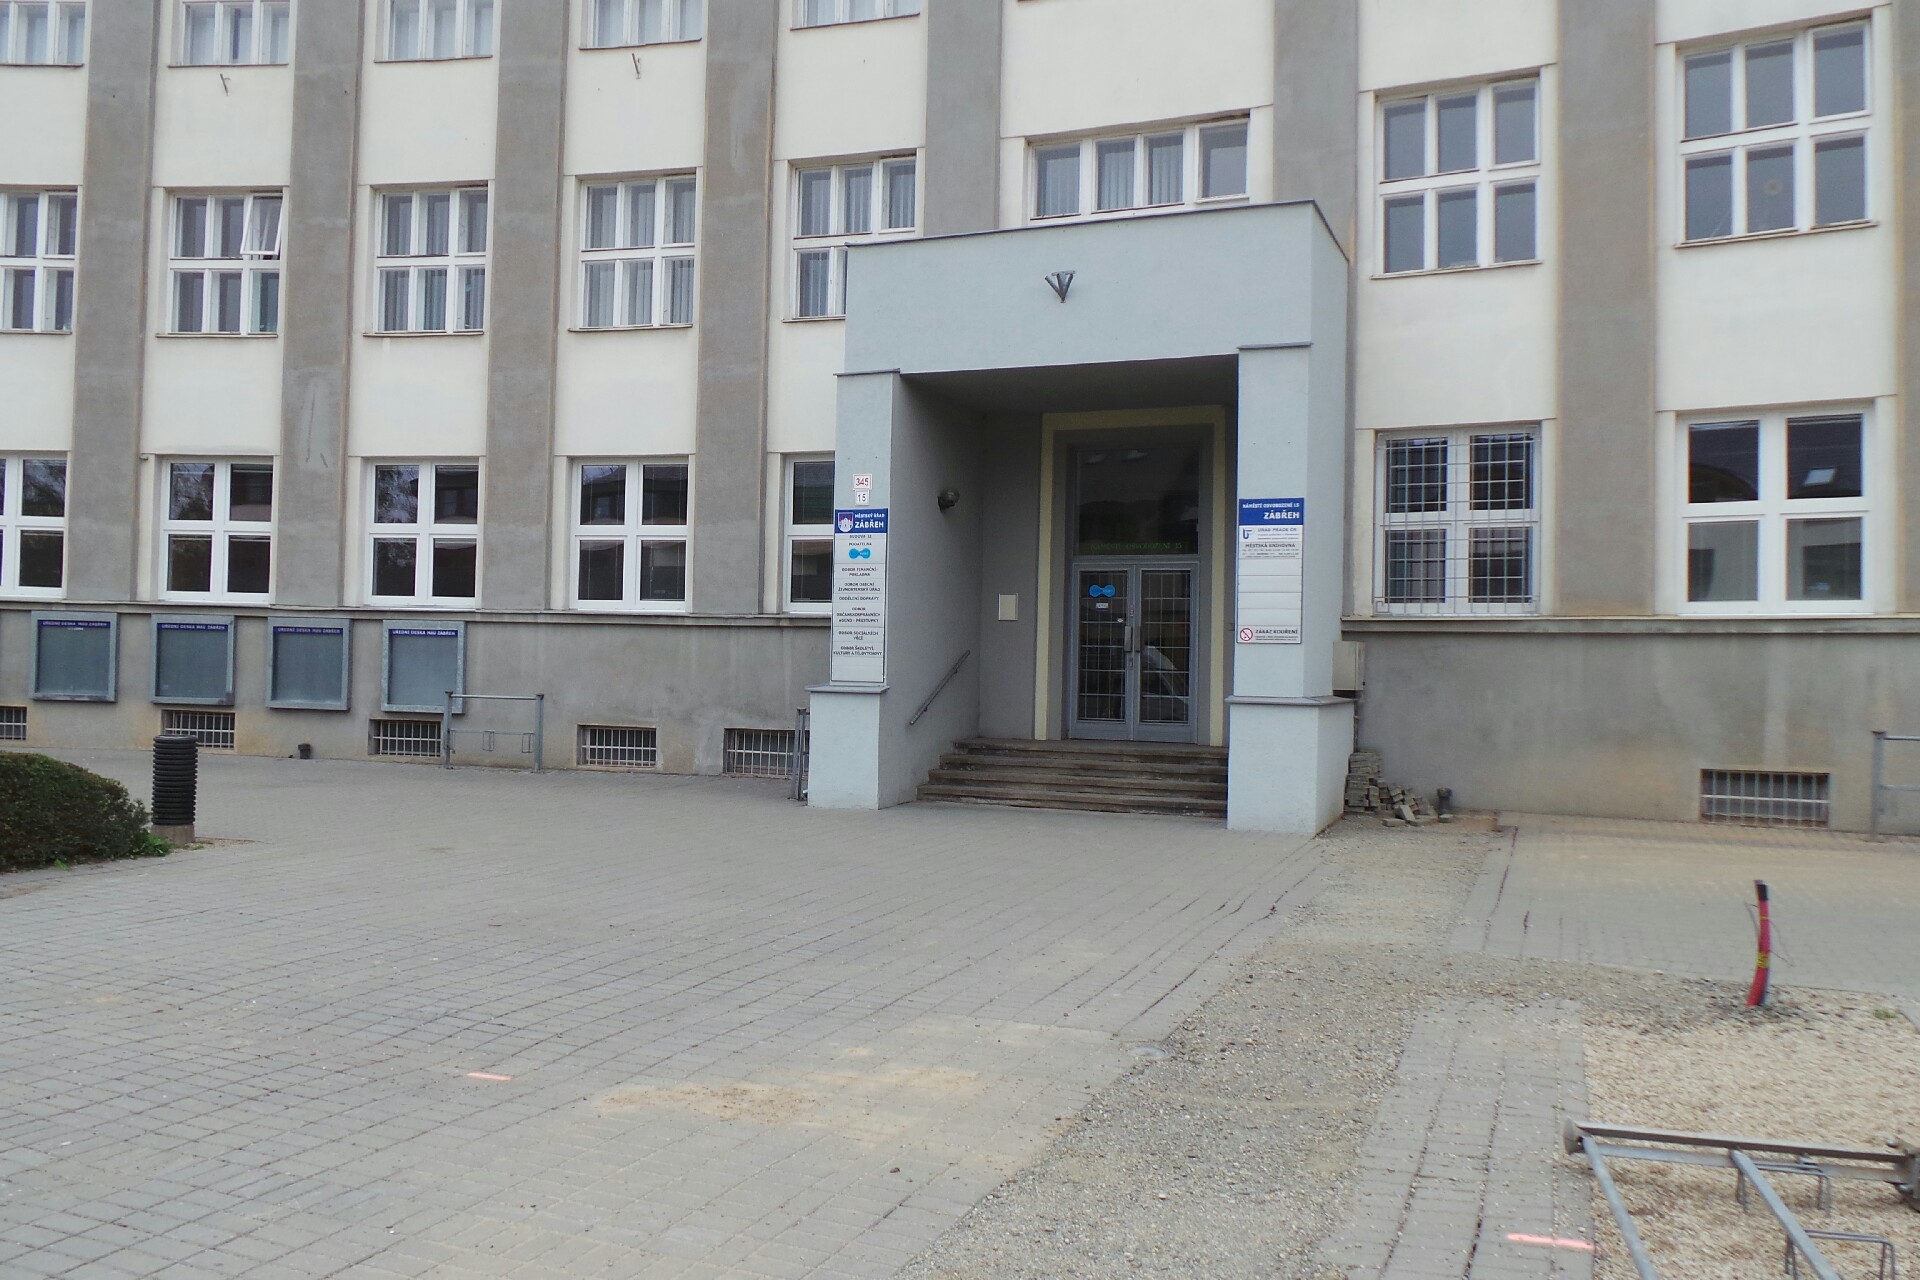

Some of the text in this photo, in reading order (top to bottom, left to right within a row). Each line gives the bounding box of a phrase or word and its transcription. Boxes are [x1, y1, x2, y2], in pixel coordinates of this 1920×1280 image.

[855, 477, 869, 487] 345
[857, 493, 867, 502] 15
[1263, 509, 1300, 520] ZÁBŘEH
[854, 519, 884, 529] ZÁBŘEH
